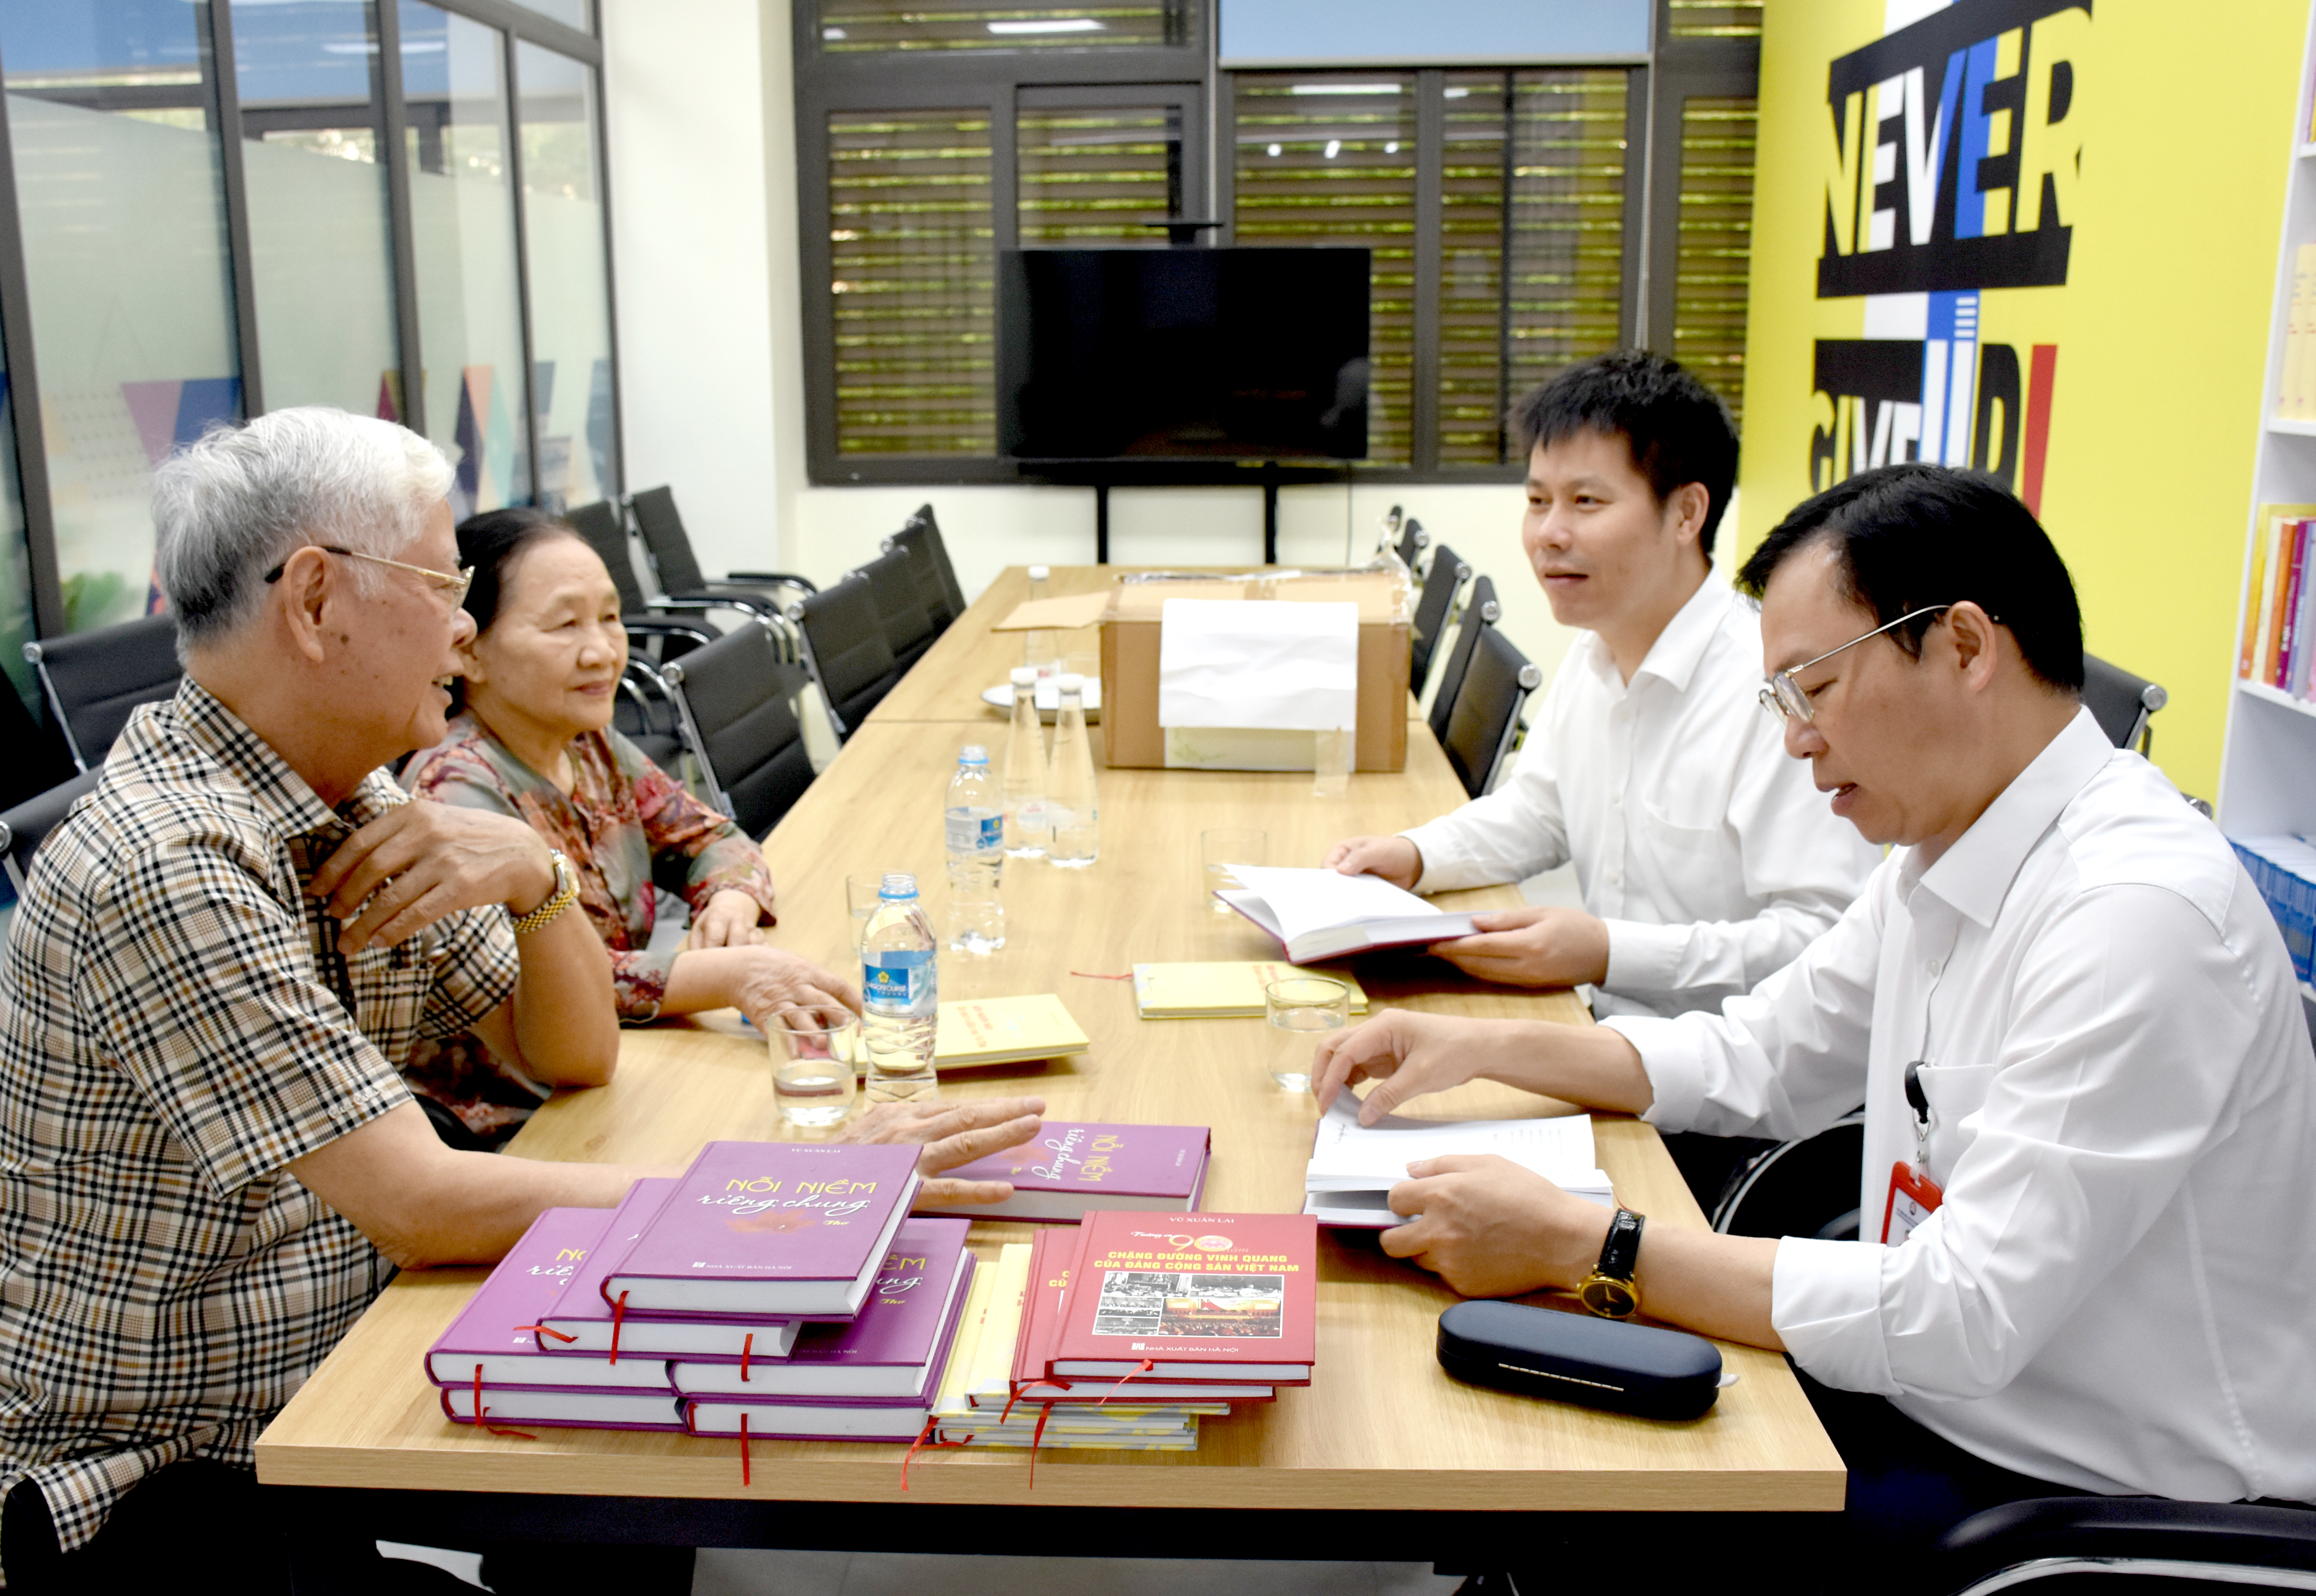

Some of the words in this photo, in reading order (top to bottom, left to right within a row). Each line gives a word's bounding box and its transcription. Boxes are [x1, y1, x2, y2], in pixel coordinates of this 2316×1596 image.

[1824, 6, 2092, 257] NEVER
[1031, 1153, 1081, 1180] chung
[726, 1176, 782, 1193] NỖI
[796, 1179, 878, 1194] NIỀM
[696, 1194, 779, 1215] riêng
[782, 1194, 871, 1216] chung
[1169, 1234, 1233, 1252] 90
[1094, 1259, 1121, 1269] CỦA
[1125, 1260, 1161, 1270] ĐẢNG
[1165, 1262, 1202, 1271] CỘNG
[1205, 1263, 1232, 1271] SẢN
[1236, 1263, 1265, 1273] VIỆT
[1108, 1251, 1153, 1260] CHẶNG
[1156, 1251, 1202, 1261] ĐƯỜNG
[1244, 1254, 1287, 1263] QUANG
